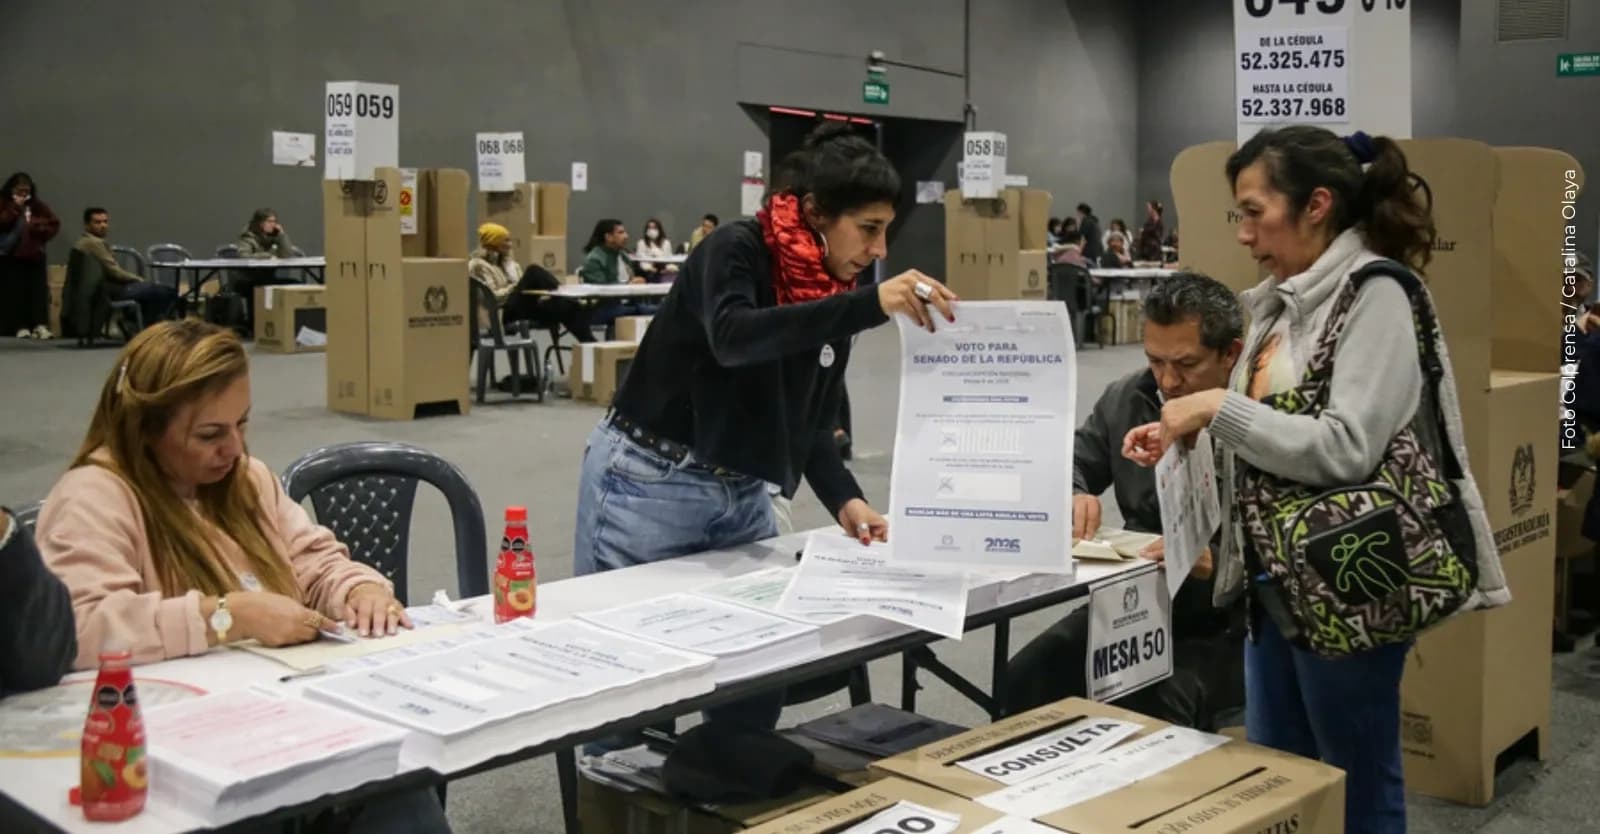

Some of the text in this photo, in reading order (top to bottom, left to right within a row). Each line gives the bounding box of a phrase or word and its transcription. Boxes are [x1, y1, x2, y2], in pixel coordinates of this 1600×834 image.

[1260, 34, 1324, 47] DE LA CÉDULA
[1241, 50, 1345, 70] 52.325.475
[1253, 81, 1333, 94] HASTA LA CÉDULA
[328, 93, 352, 117] 059
[356, 93, 394, 119] 059
[1242, 98, 1345, 116] 52.337.968
[479, 140, 500, 155] 068
[967, 139, 991, 156] 058
[954, 342, 1018, 351] VOTO PARA
[913, 354, 959, 364] SENADO
[962, 354, 976, 364] DE
[980, 354, 994, 364] LA
[1093, 627, 1165, 680] MESA 50
[983, 721, 1121, 777] CONSULTA
